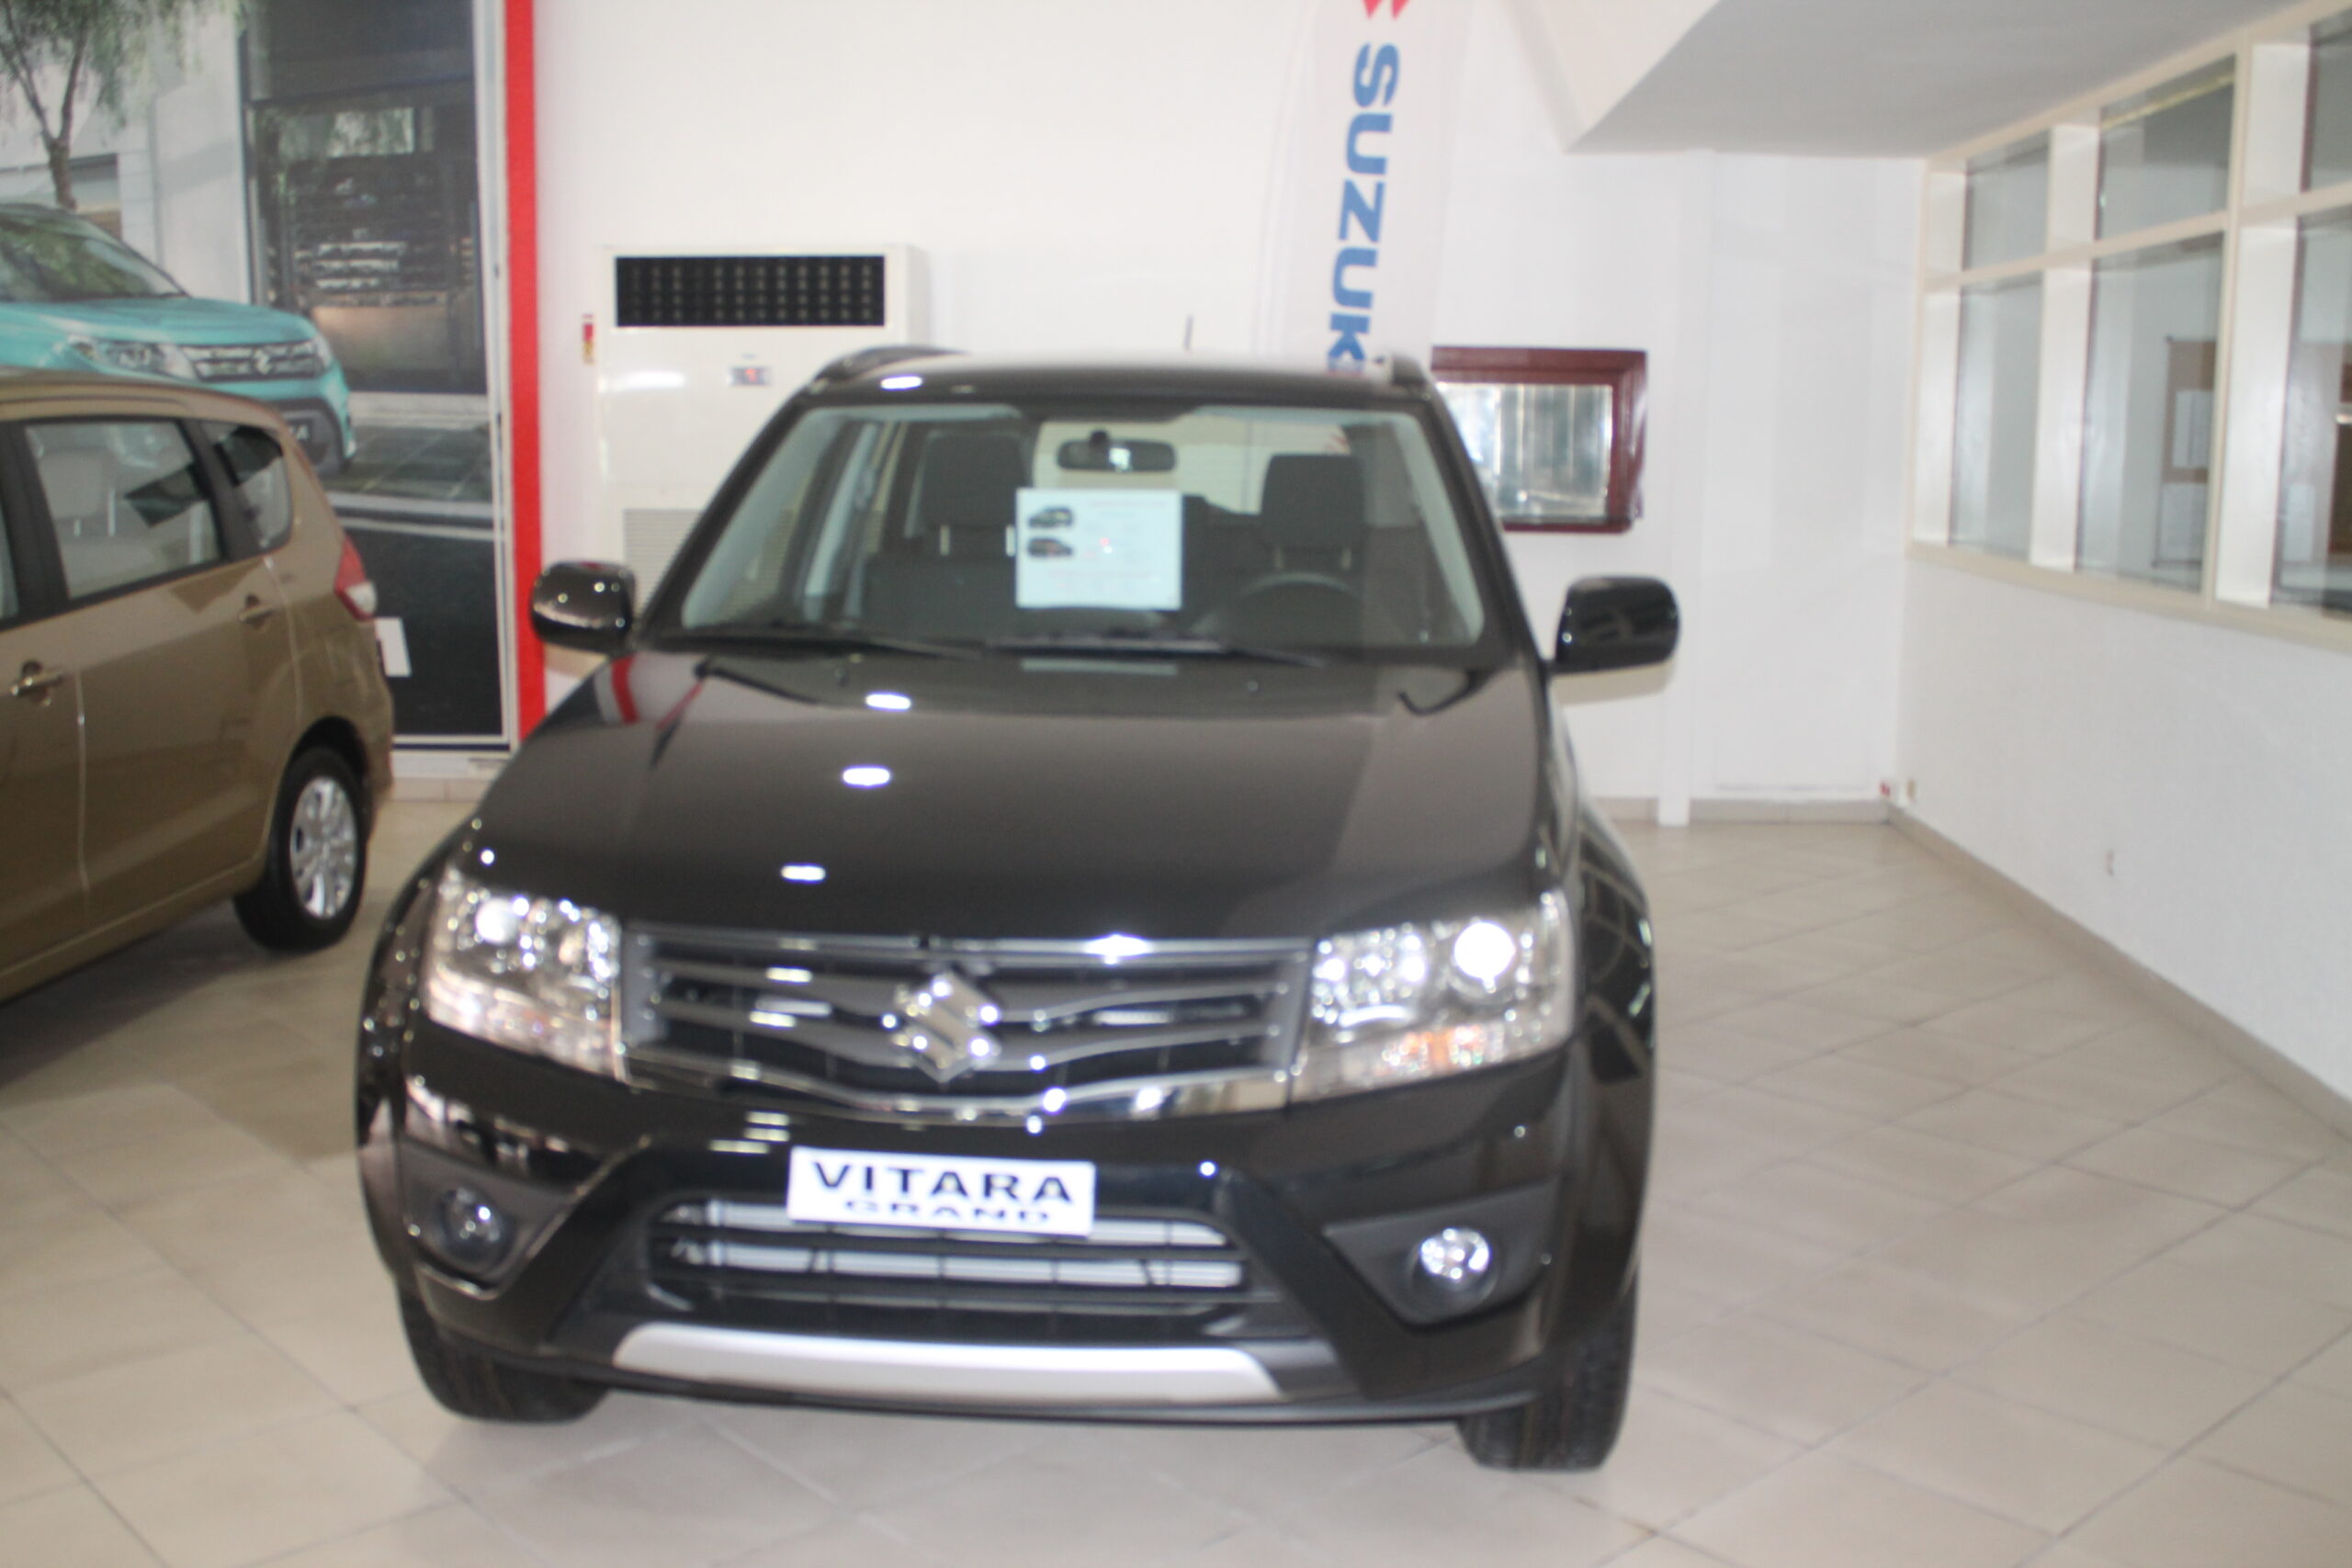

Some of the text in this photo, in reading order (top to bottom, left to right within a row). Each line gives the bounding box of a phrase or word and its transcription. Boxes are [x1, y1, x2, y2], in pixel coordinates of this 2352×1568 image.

[1326, 42, 1400, 361] SUZUK
[814, 1161, 1071, 1202] VITARA
[845, 1199, 1049, 1223] GRAND
